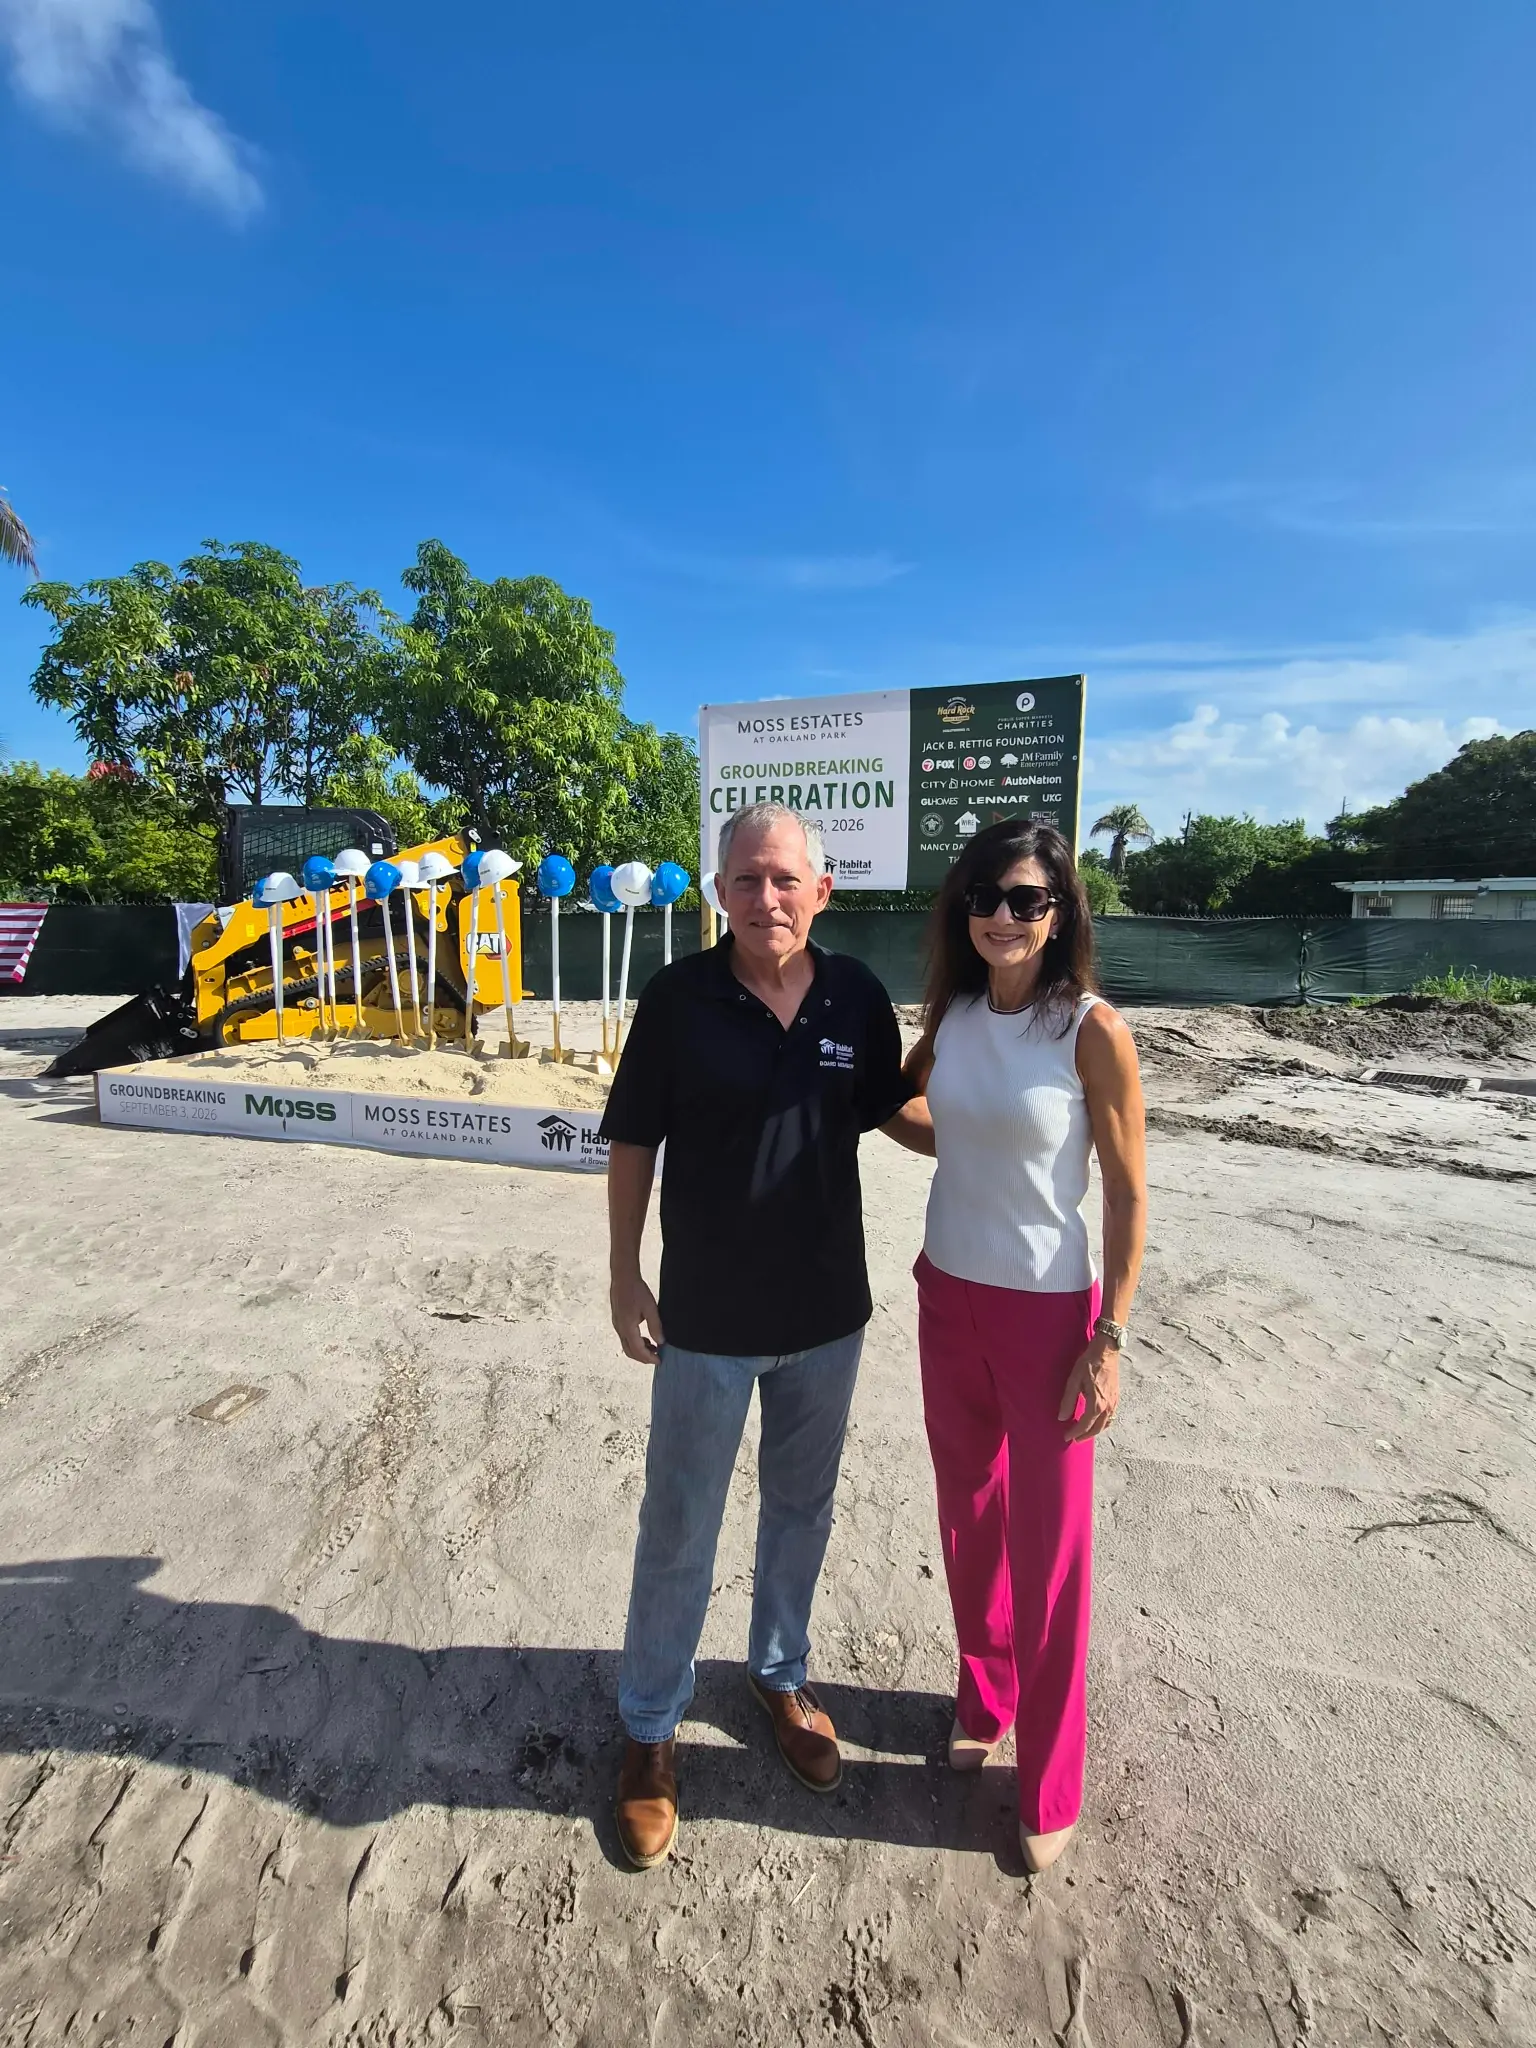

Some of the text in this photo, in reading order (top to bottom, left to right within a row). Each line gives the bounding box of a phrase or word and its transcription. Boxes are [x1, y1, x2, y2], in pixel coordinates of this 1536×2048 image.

[937, 704, 976, 715] Hard Rock
[737, 712, 864, 733] MOSS ESTATES
[997, 719, 1053, 730] CHARITIES
[753, 731, 847, 744] AT OAKLAND PARK
[922, 735, 1065, 753] JACK B. RETTIG FOUNDATION
[1020, 750, 1064, 762] JM Family
[720, 757, 883, 780] GROUNDBREAKING
[936, 759, 955, 769] FOX
[1020, 760, 1059, 769] Enterprises
[921, 778, 996, 789] CITY HOME
[968, 795, 1031, 805] LENNAR
[1042, 793, 1062, 802] UKG
[831, 818, 865, 832] 2026
[920, 843, 951, 851] NANCY
[839, 859, 872, 869] Habitat
[109, 1083, 226, 1105] GROUNDBREAKING
[119, 1101, 217, 1121] SEPTEMBER 3, 2026
[365, 1104, 511, 1134] MOSS ESTATES
[383, 1127, 493, 1146] AT OAKLAND PARK
[581, 1128, 609, 1145] Hab
[581, 1145, 593, 1154] for
